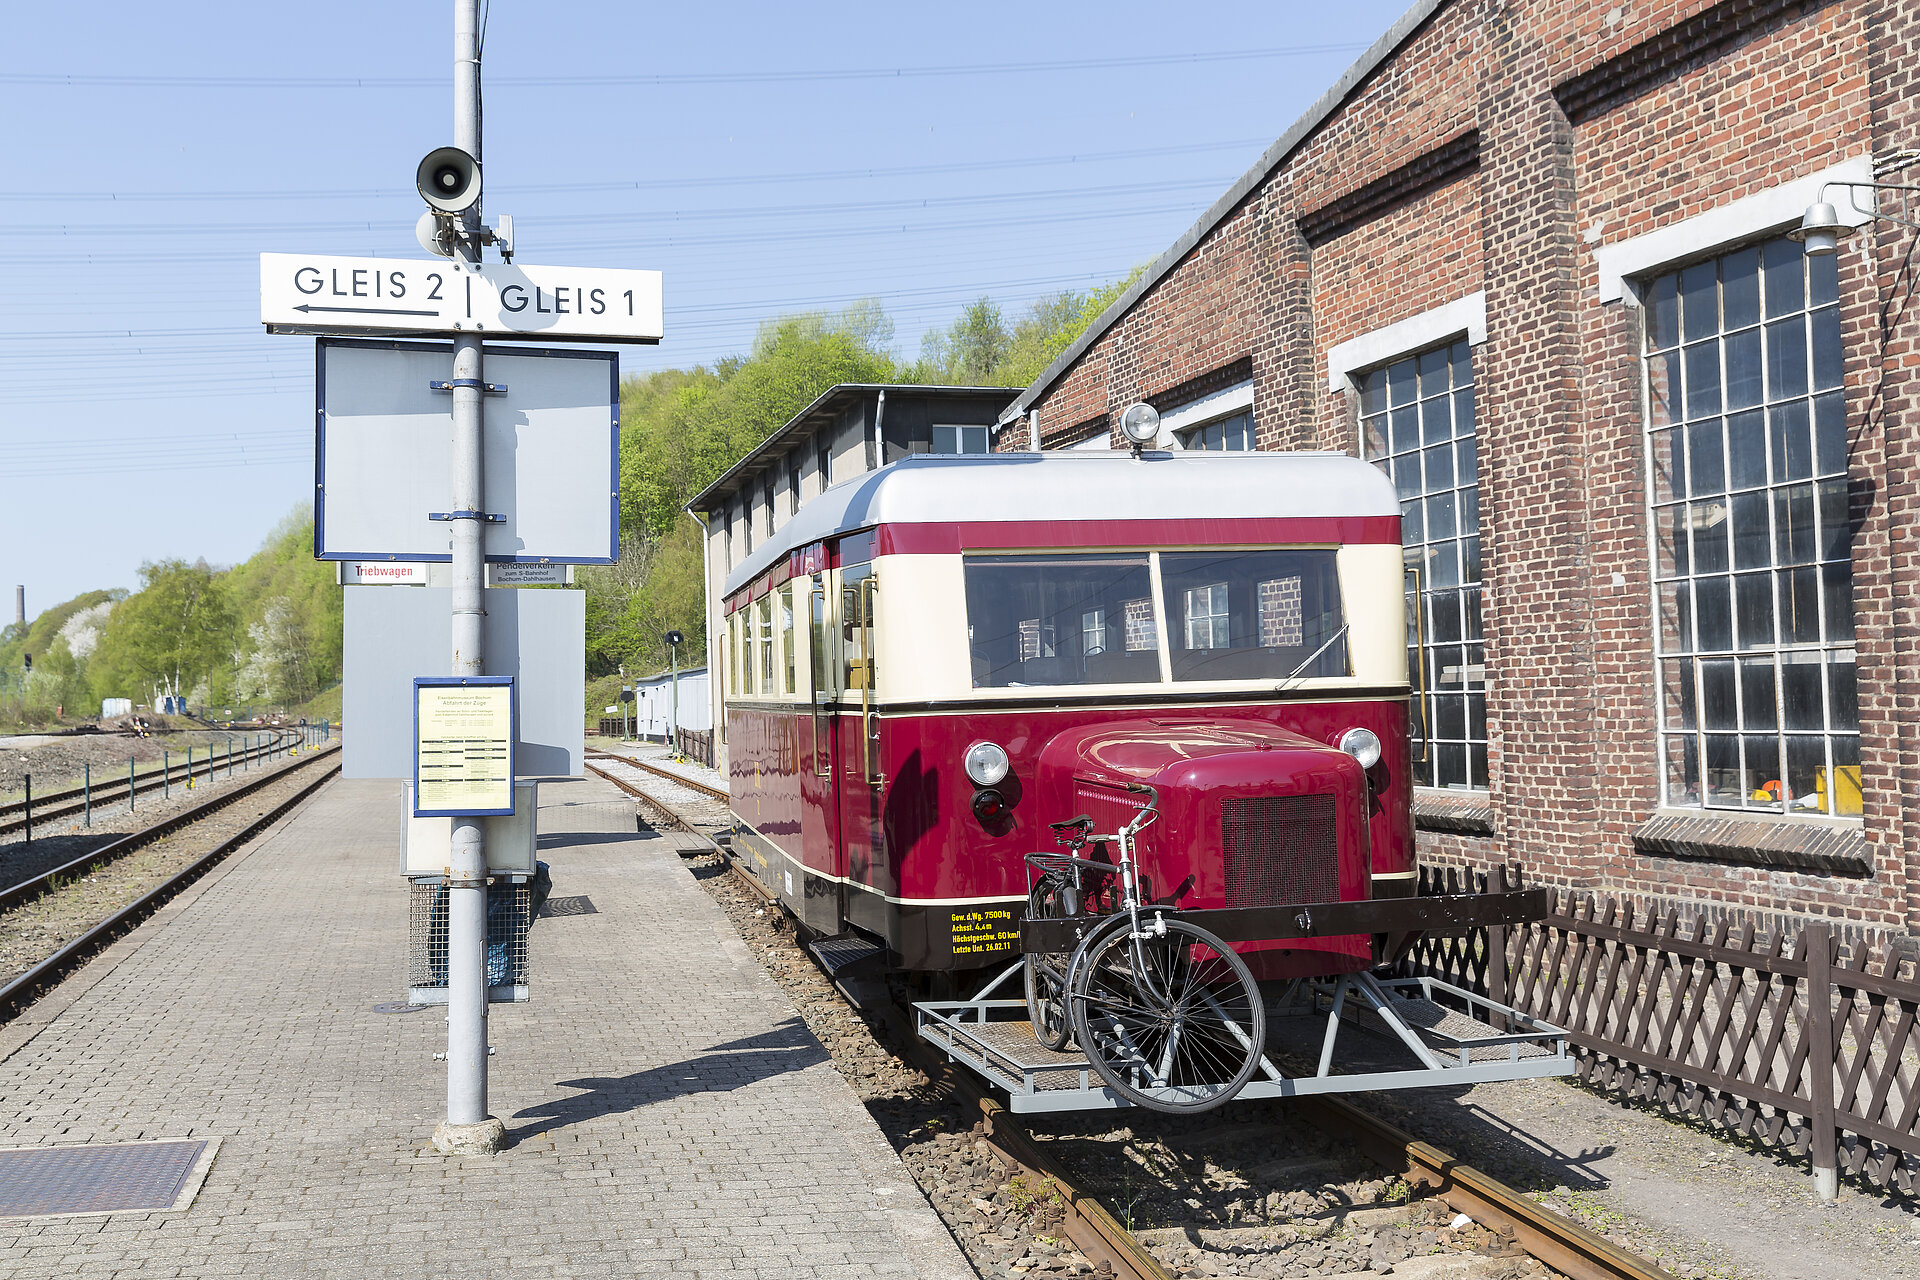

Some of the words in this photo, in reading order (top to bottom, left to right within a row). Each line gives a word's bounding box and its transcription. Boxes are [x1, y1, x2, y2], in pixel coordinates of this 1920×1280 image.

[294, 266, 407, 299] GLEIS
[426, 273, 444, 300] 2
[499, 284, 607, 315] GLEIS
[623, 289, 634, 316] 1
[355, 565, 413, 579] Triebwagen
[952, 934, 997, 943] Höchstgeschw.
[986, 942, 1011, 951] 26.02.11
